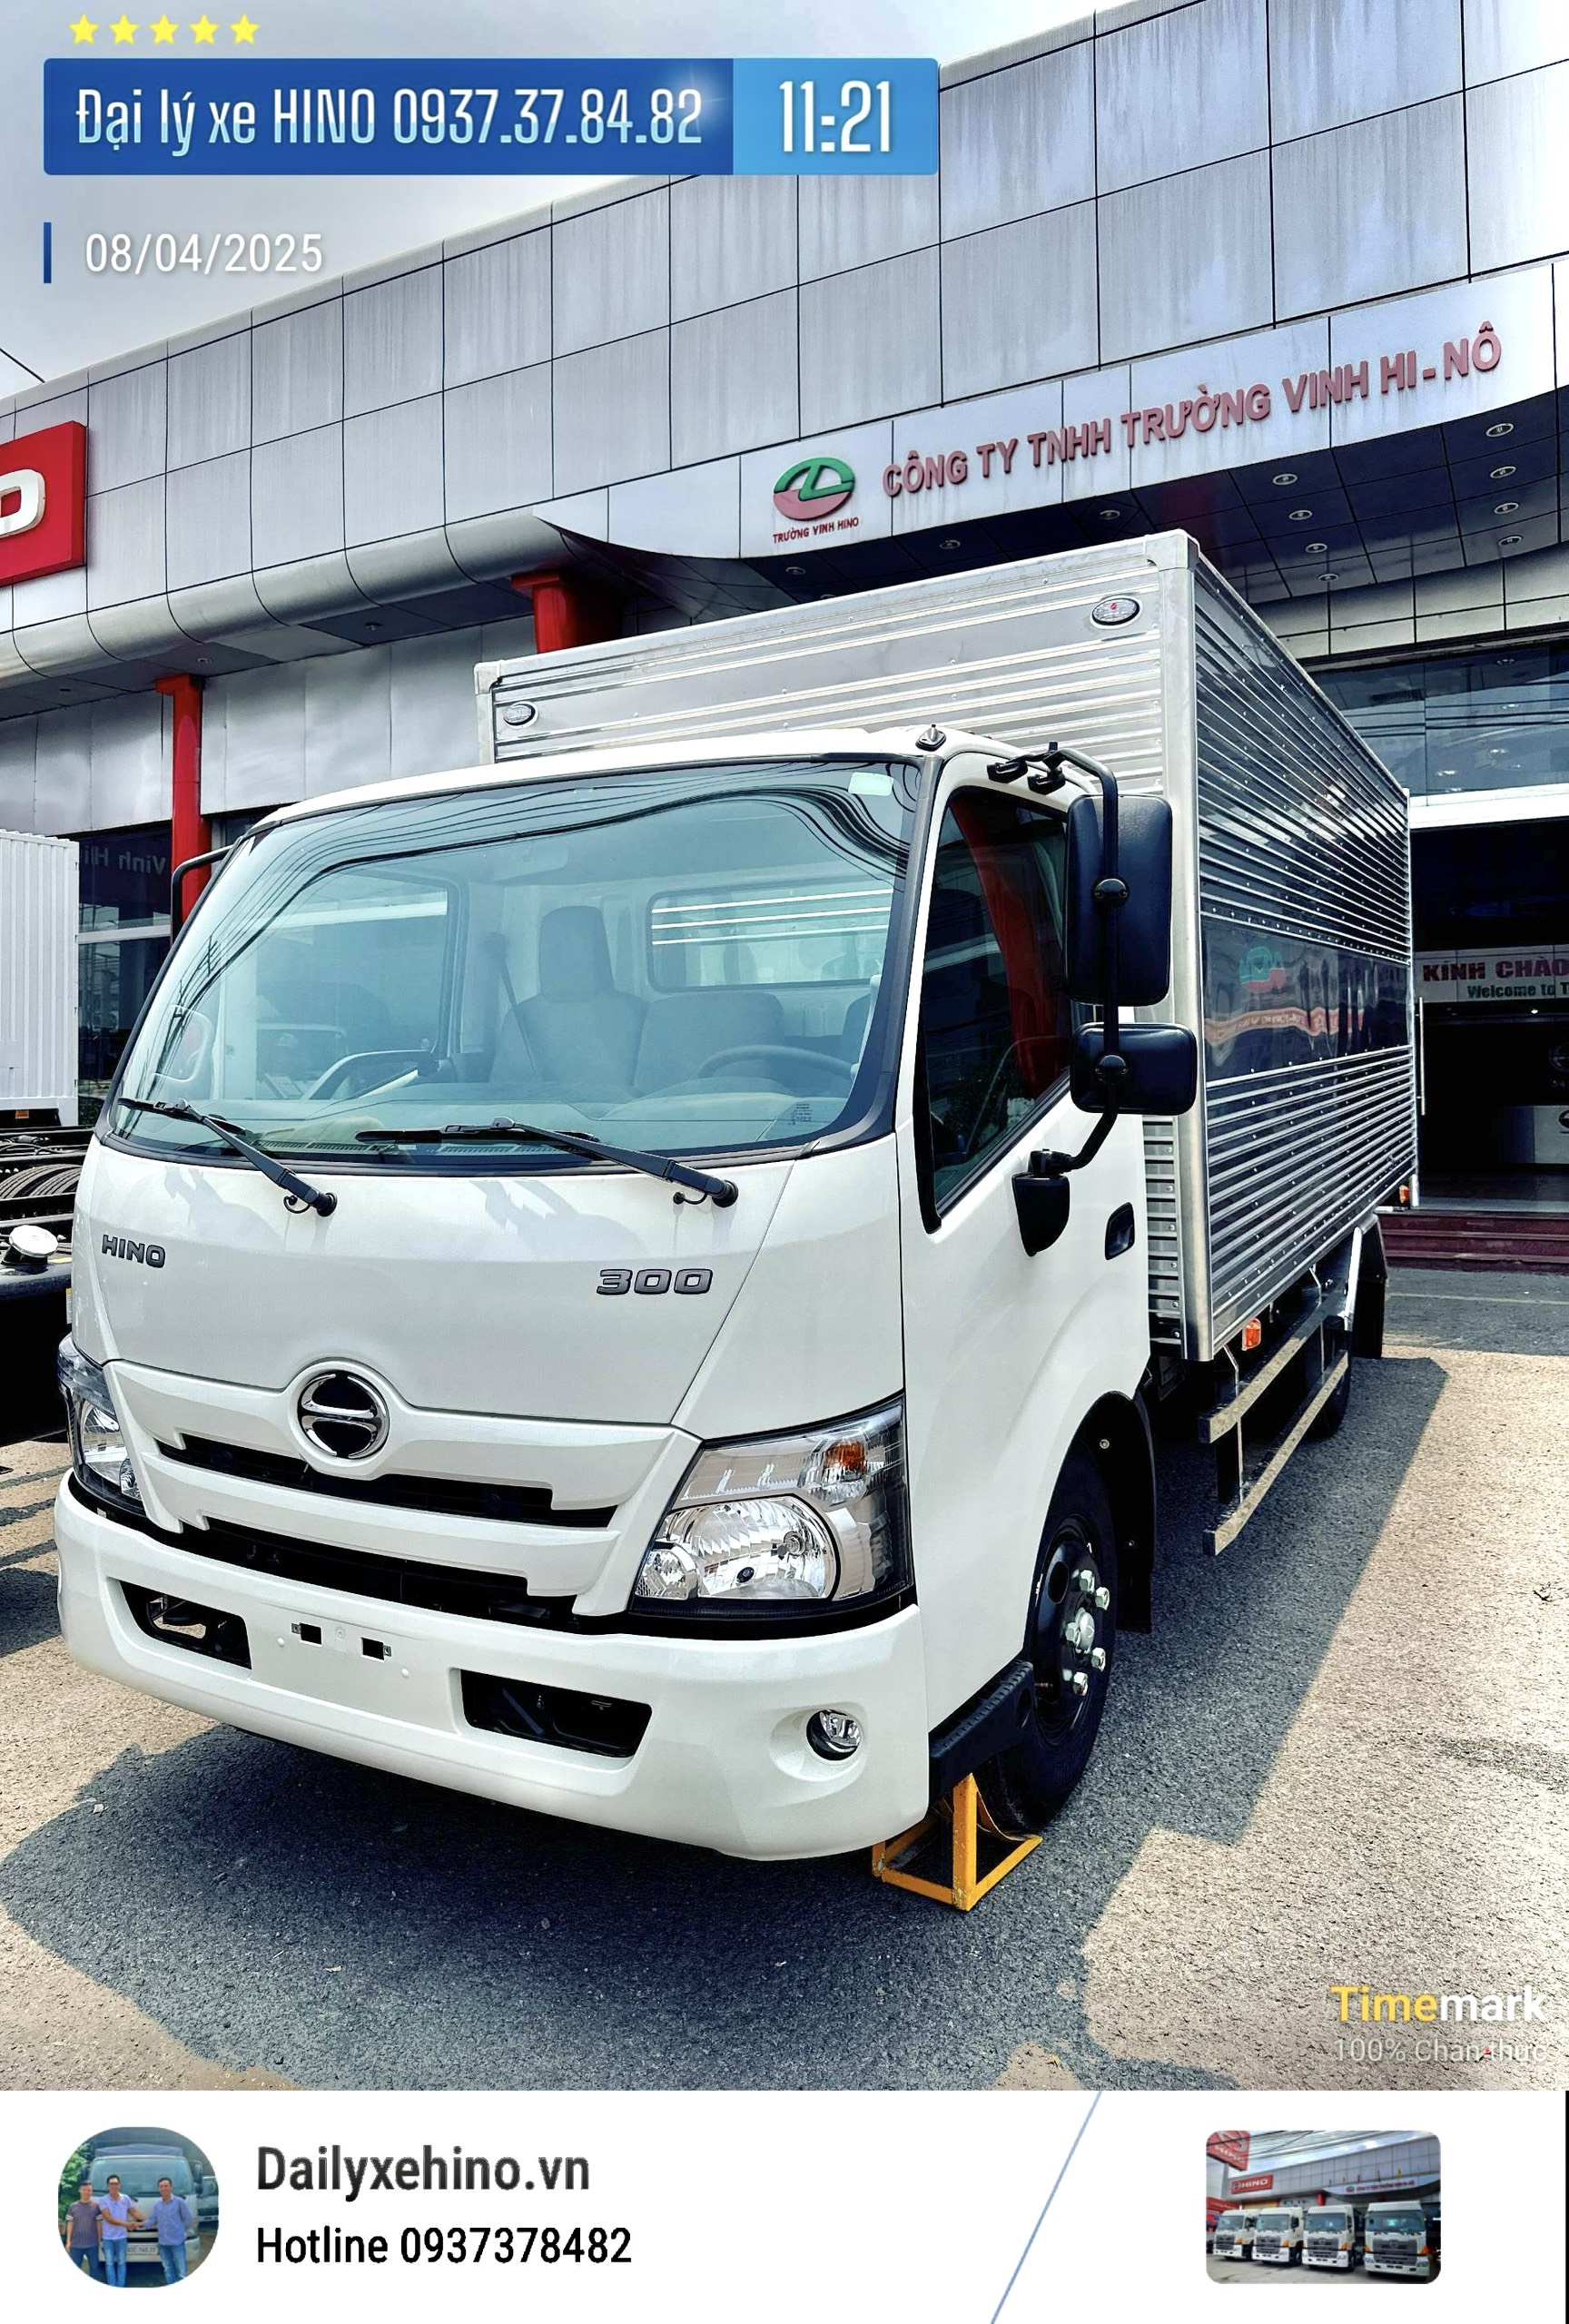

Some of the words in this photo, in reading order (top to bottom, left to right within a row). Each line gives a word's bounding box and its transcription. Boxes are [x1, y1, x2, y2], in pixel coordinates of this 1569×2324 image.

[883, 449, 968, 497] CÔNG
[976, 438, 1019, 478] TY
[1027, 418, 1111, 468] TNHH
[1120, 383, 1270, 448] TRƯỜNG
[1281, 359, 1368, 413] VINH
[813, 521, 834, 536] VINH
[837, 517, 860, 531] HINO
[1423, 960, 1485, 981] KÍNH
[1467, 984, 1536, 999] Welcome
[102, 1234, 166, 1268] HINO
[596, 1268, 714, 1295] 300
